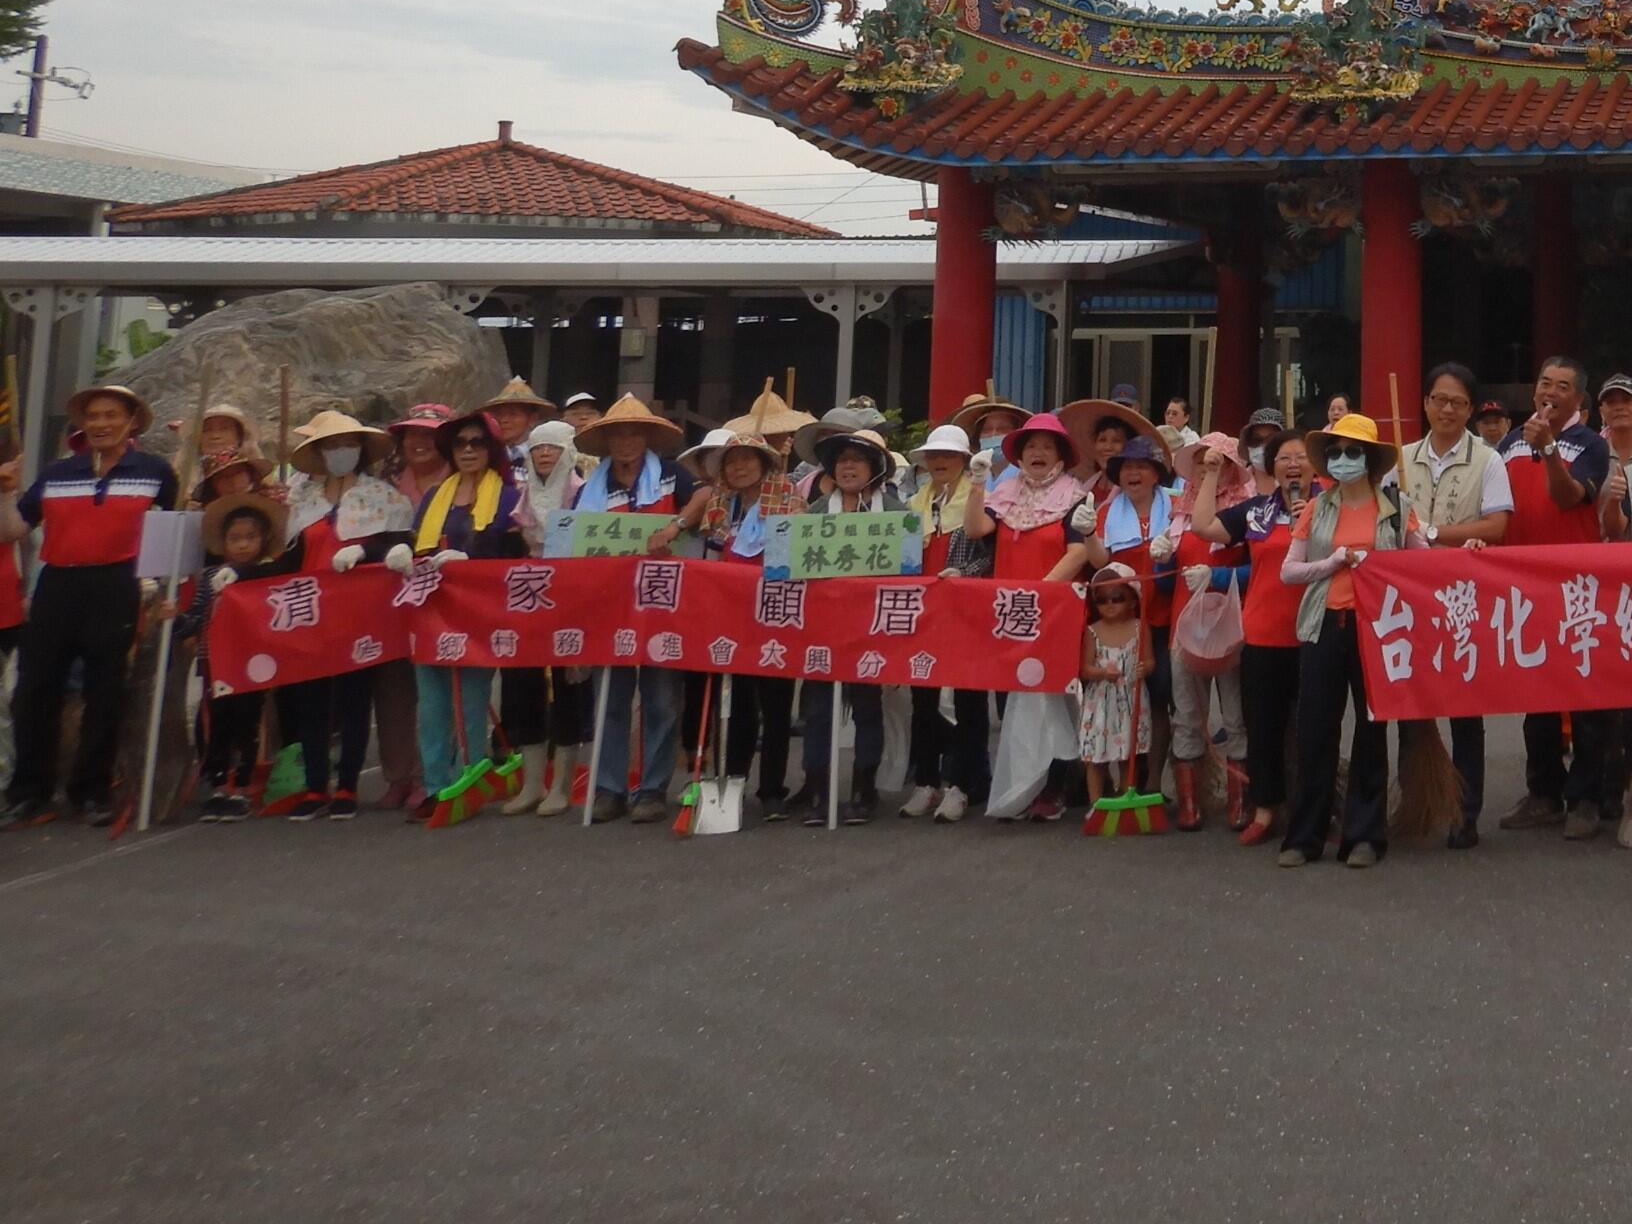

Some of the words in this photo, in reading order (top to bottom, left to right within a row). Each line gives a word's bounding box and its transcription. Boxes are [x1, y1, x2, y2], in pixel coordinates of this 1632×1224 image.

[801, 542, 894, 573] 林秀花
[267, 556, 1041, 641] 清淨家園顧厝邊
